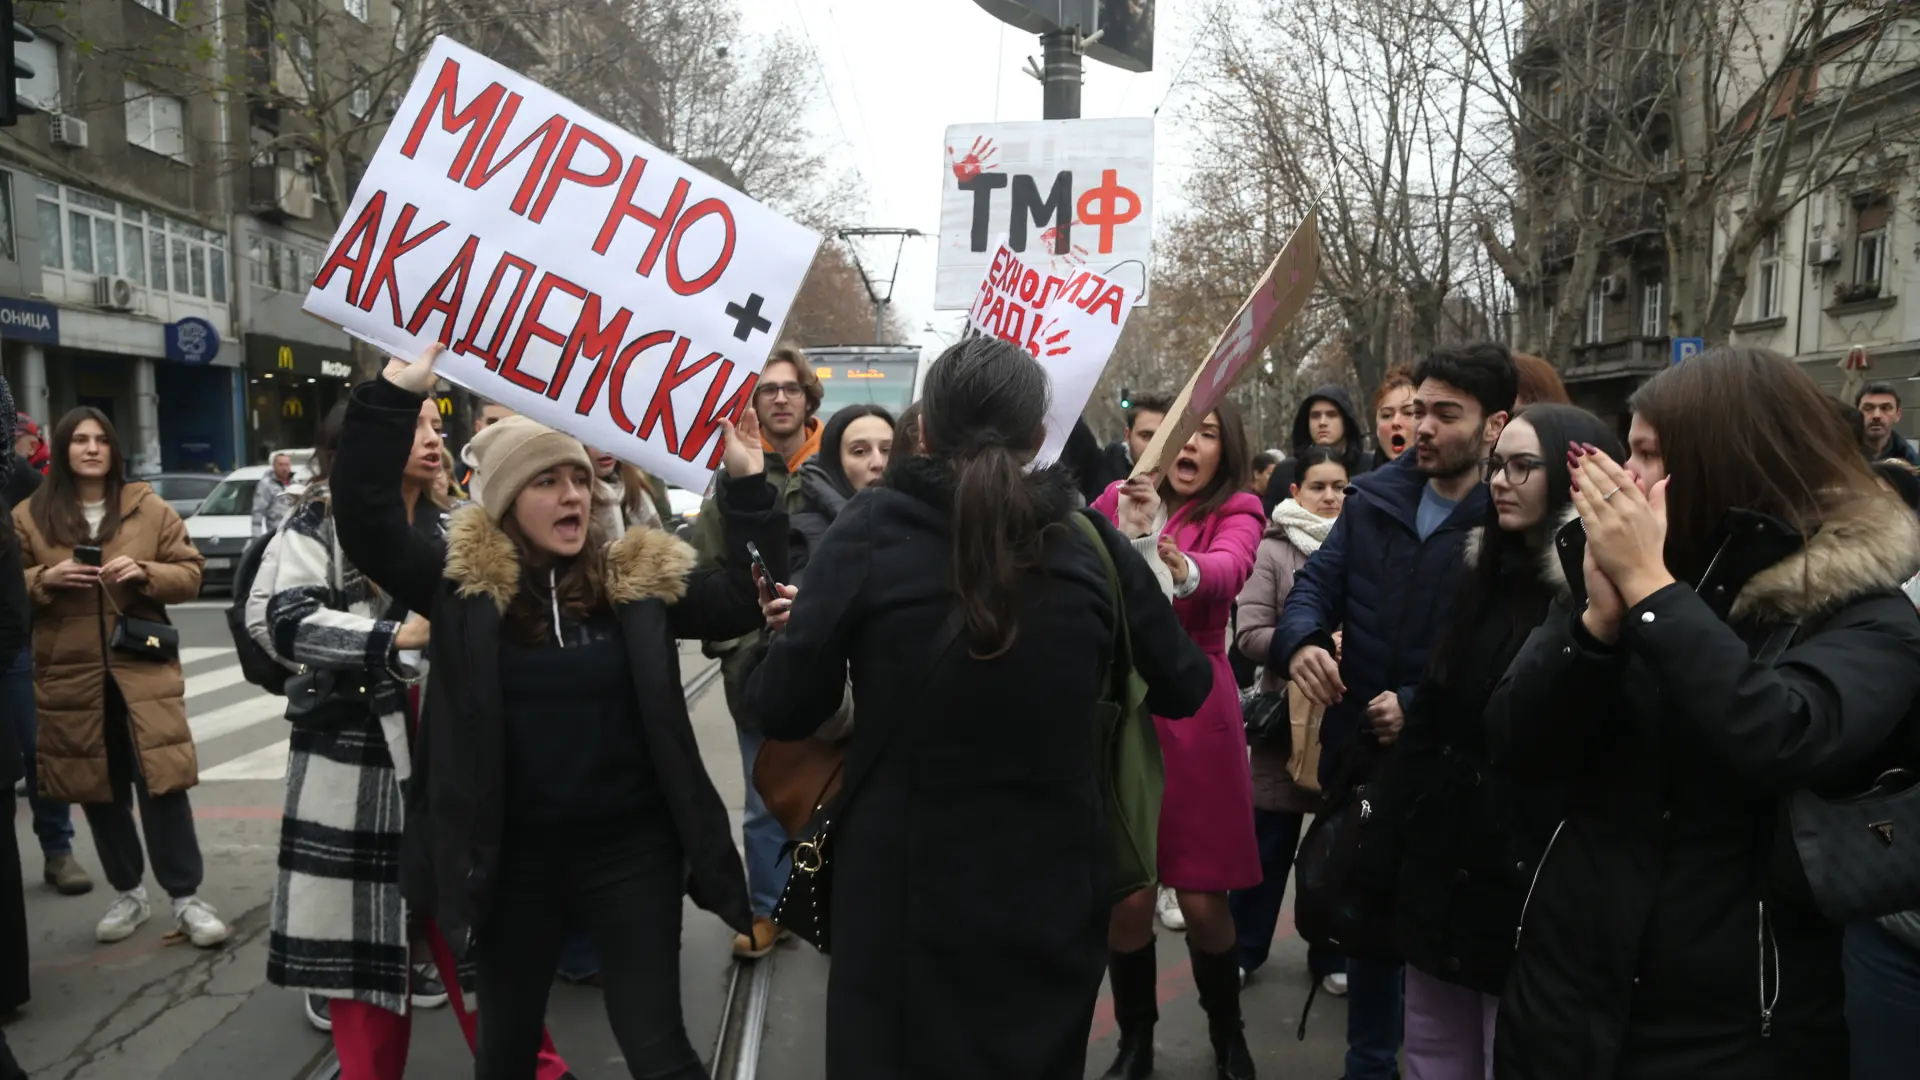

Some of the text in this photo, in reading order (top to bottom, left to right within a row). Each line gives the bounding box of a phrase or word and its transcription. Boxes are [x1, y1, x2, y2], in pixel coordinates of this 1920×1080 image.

[400, 57, 737, 297] МИРНО
[957, 168, 1142, 255] ТМФ
[313, 189, 760, 471] АКАДЕМСКИ
[1680, 342, 1697, 361] P
